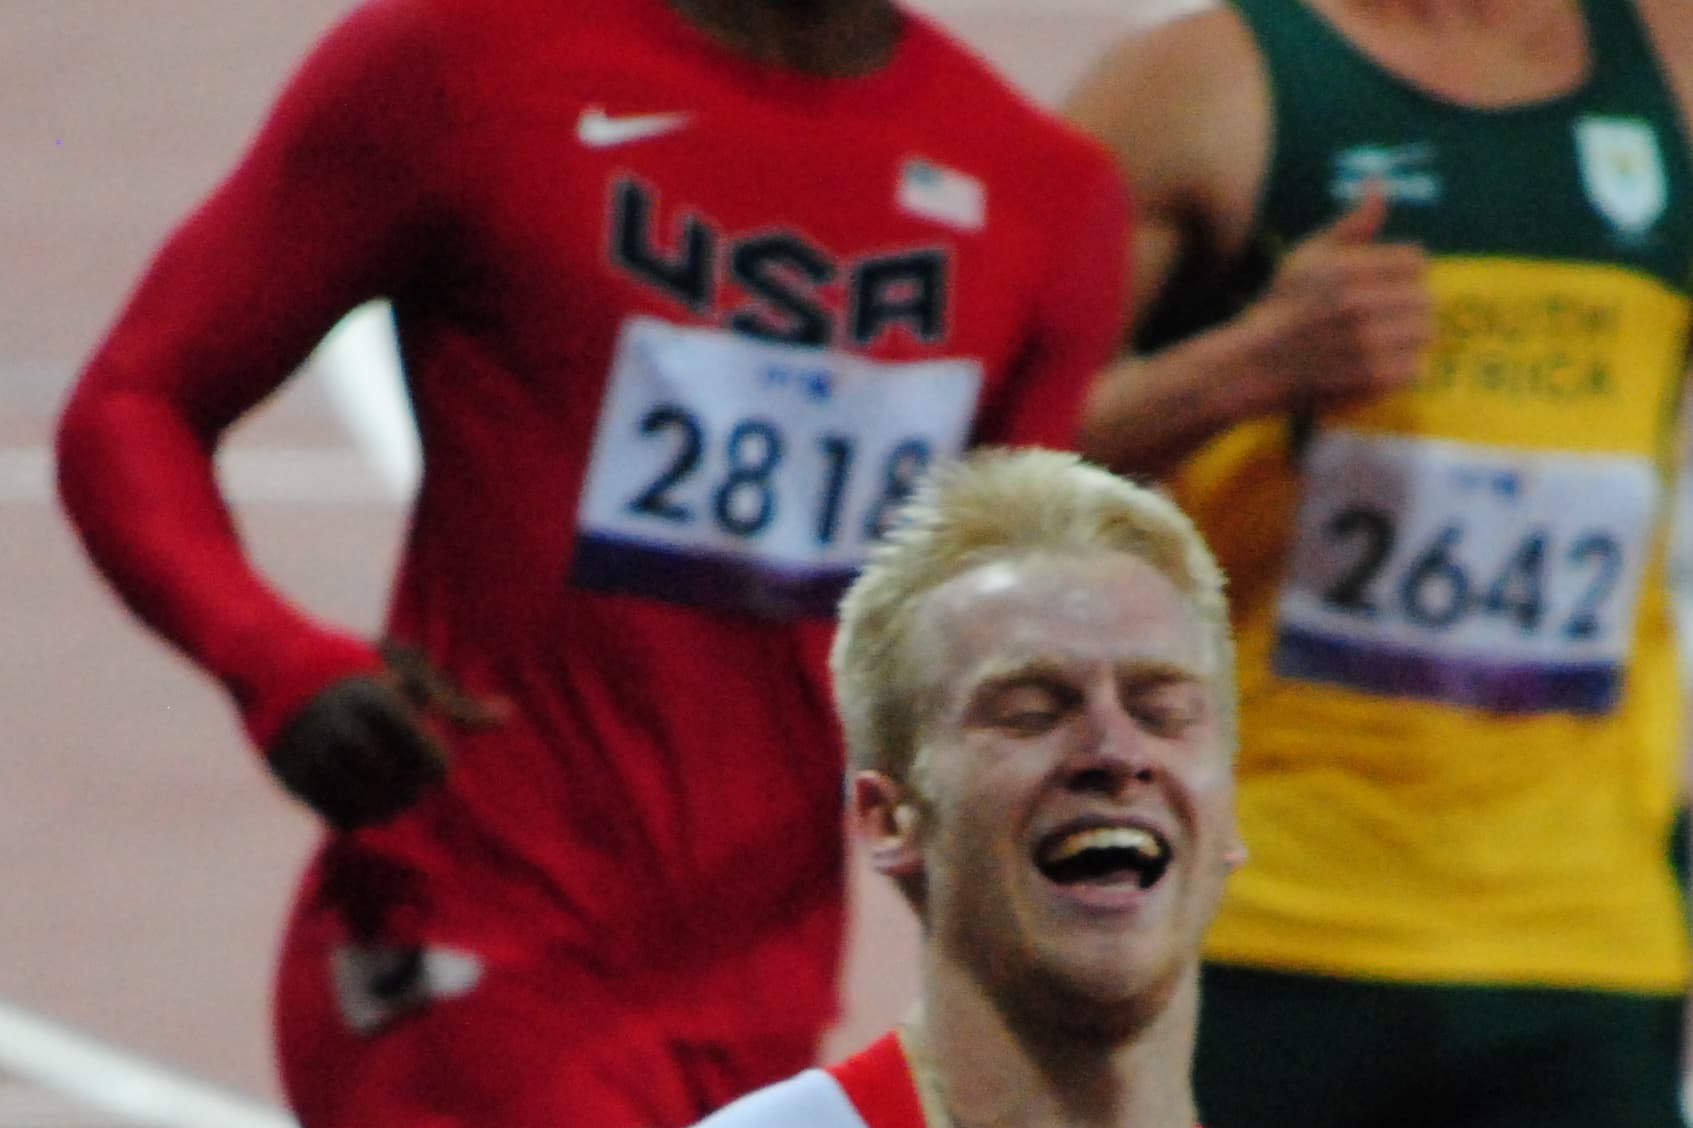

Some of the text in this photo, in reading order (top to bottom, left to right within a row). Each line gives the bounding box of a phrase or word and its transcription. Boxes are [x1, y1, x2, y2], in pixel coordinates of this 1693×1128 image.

[609, 172, 955, 349] USA
[1437, 297, 1618, 342] OUTH
[1432, 350, 1614, 395] FRICA
[1321, 509, 1623, 641] 2642
